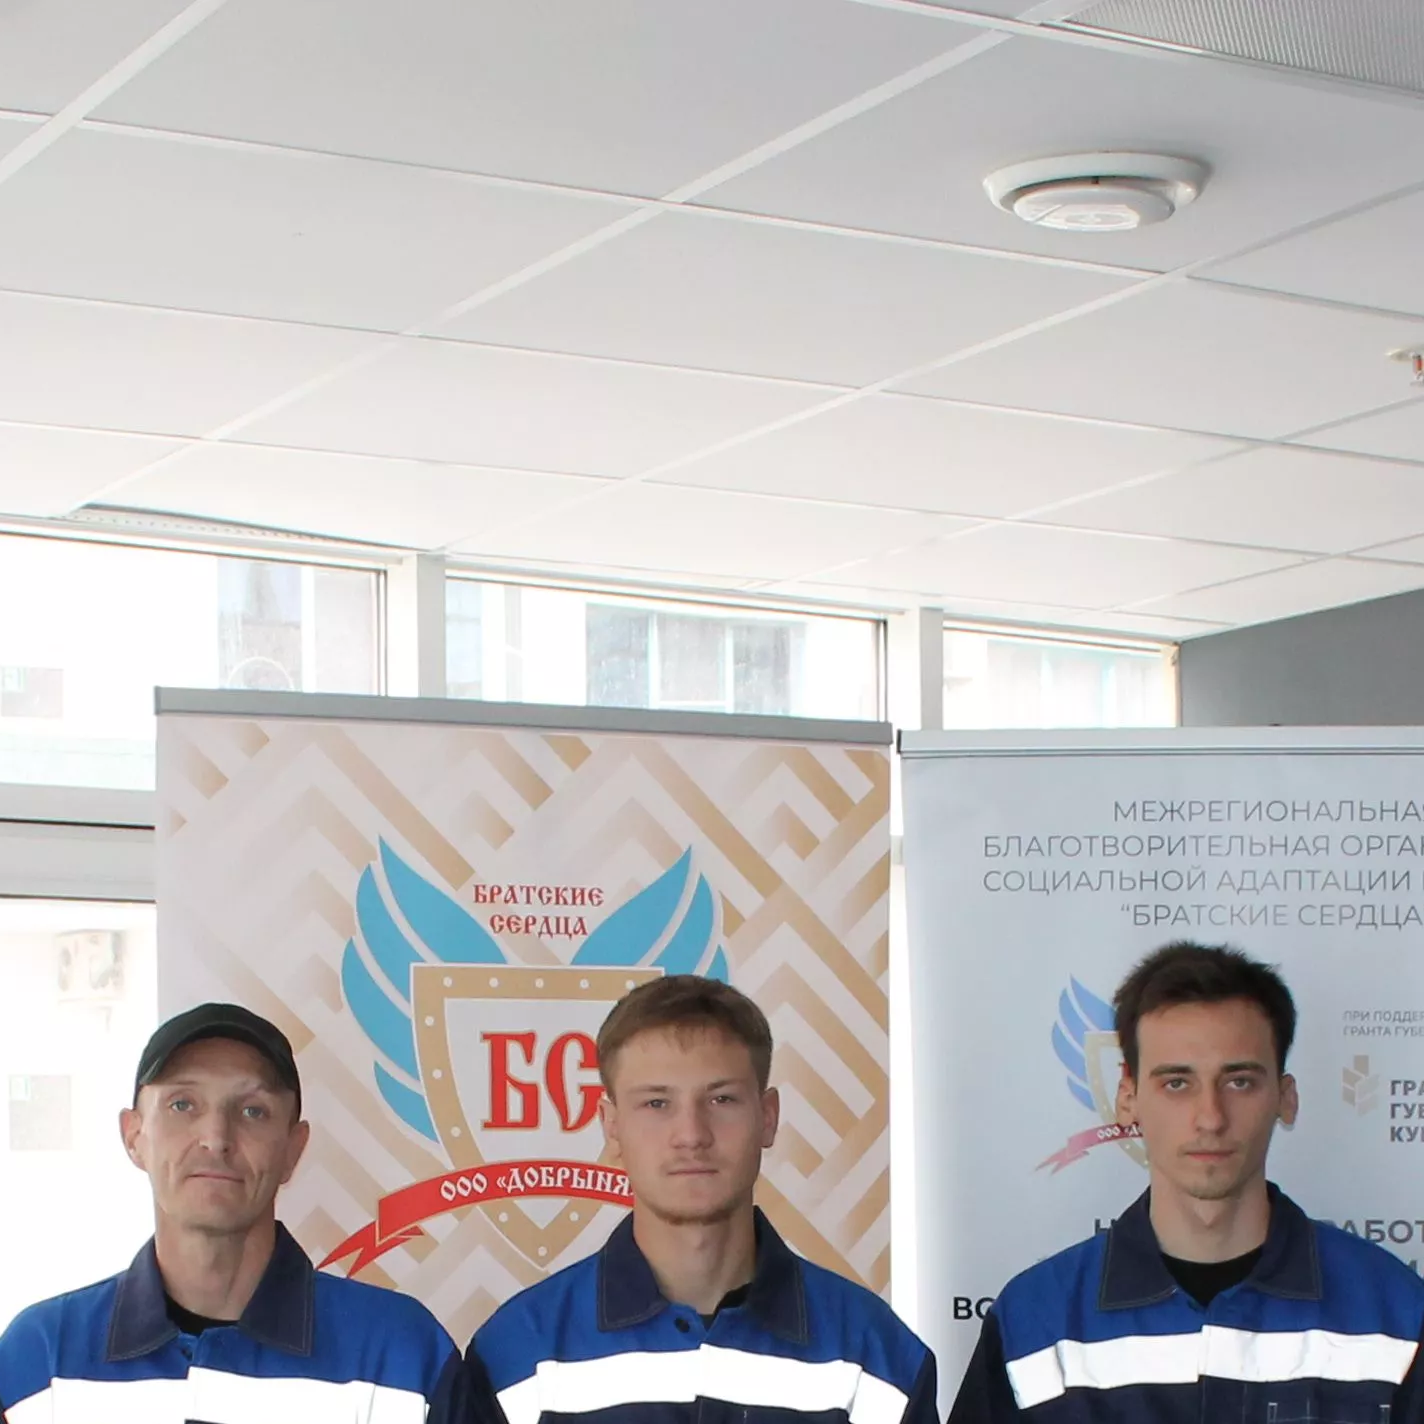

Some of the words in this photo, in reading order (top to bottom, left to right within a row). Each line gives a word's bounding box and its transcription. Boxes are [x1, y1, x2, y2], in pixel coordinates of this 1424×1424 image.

[983, 835, 1329, 858] БЛАГОТВОРИТЕЛЬНАЯ
[983, 865, 1207, 896] СОЦИАЛЬНОЙ
[1216, 869, 1411, 896] АДАПТАЦИИ
[473, 884, 604, 907] БРАТСКИЕ
[489, 914, 588, 940] СЕРДЦА
[1343, 1010, 1370, 1022] ПРИ
[1343, 1025, 1392, 1037] ГРАНТА
[440, 1172, 488, 1201] ООО
[496, 1166, 634, 1197] «ДОБРЫНЯ
